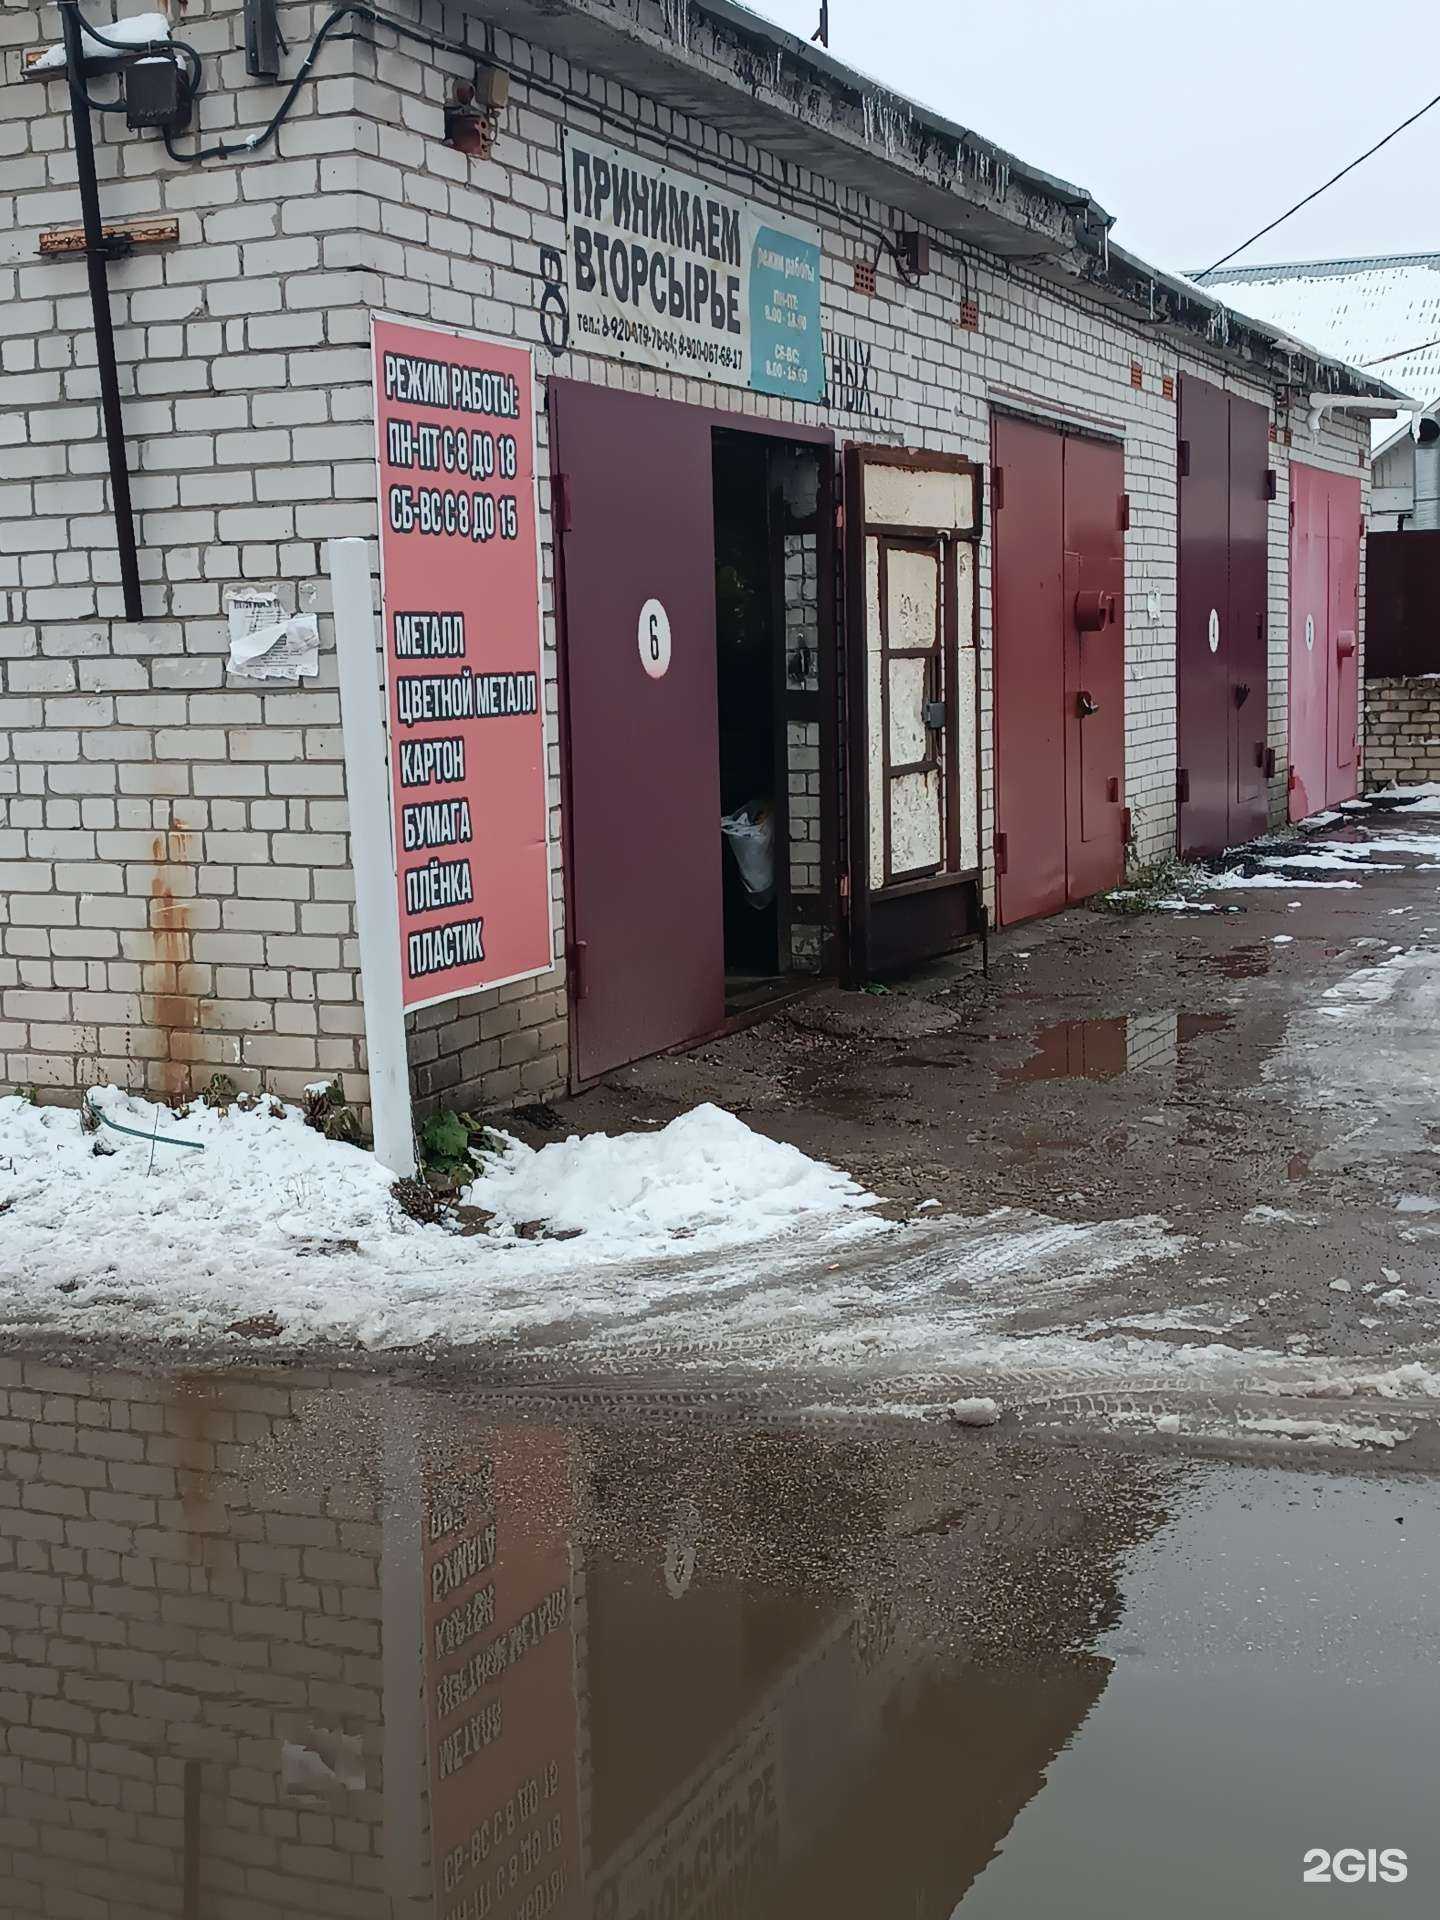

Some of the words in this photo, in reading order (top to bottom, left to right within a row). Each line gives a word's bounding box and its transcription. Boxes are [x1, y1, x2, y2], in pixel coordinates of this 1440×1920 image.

[571, 148, 741, 267] ПРИНИМАЕМ
[573, 226, 740, 334] ВТОРСЫРЬЕ
[785, 254, 815, 282] работы
[385, 354, 449, 407] РЕЖИМ
[452, 367, 519, 417] РАБОТЫ:
[388, 421, 441, 469] ПН-ПТ
[442, 429, 455, 471] С
[456, 430, 468, 472] 8
[471, 433, 494, 479] ДО
[498, 436, 517, 477] 18
[390, 487, 442, 531] СБ-ВС
[443, 491, 455, 533] С
[457, 492, 469, 535] 8
[472, 496, 495, 541] ДО
[498, 498, 517, 538] 15
[395, 614, 465, 657] МЕТАЛЛ
[650, 614, 659, 660] 6
[397, 669, 473, 725] ЦВЕТНОЙ
[476, 673, 537, 716] МЕТАЛЛ
[400, 738, 464, 785] КАРТОН
[403, 800, 471, 850] БУМАГА
[406, 860, 472, 913] ПЛЁНКА
[409, 920, 484, 976] ПЛАСТИК
